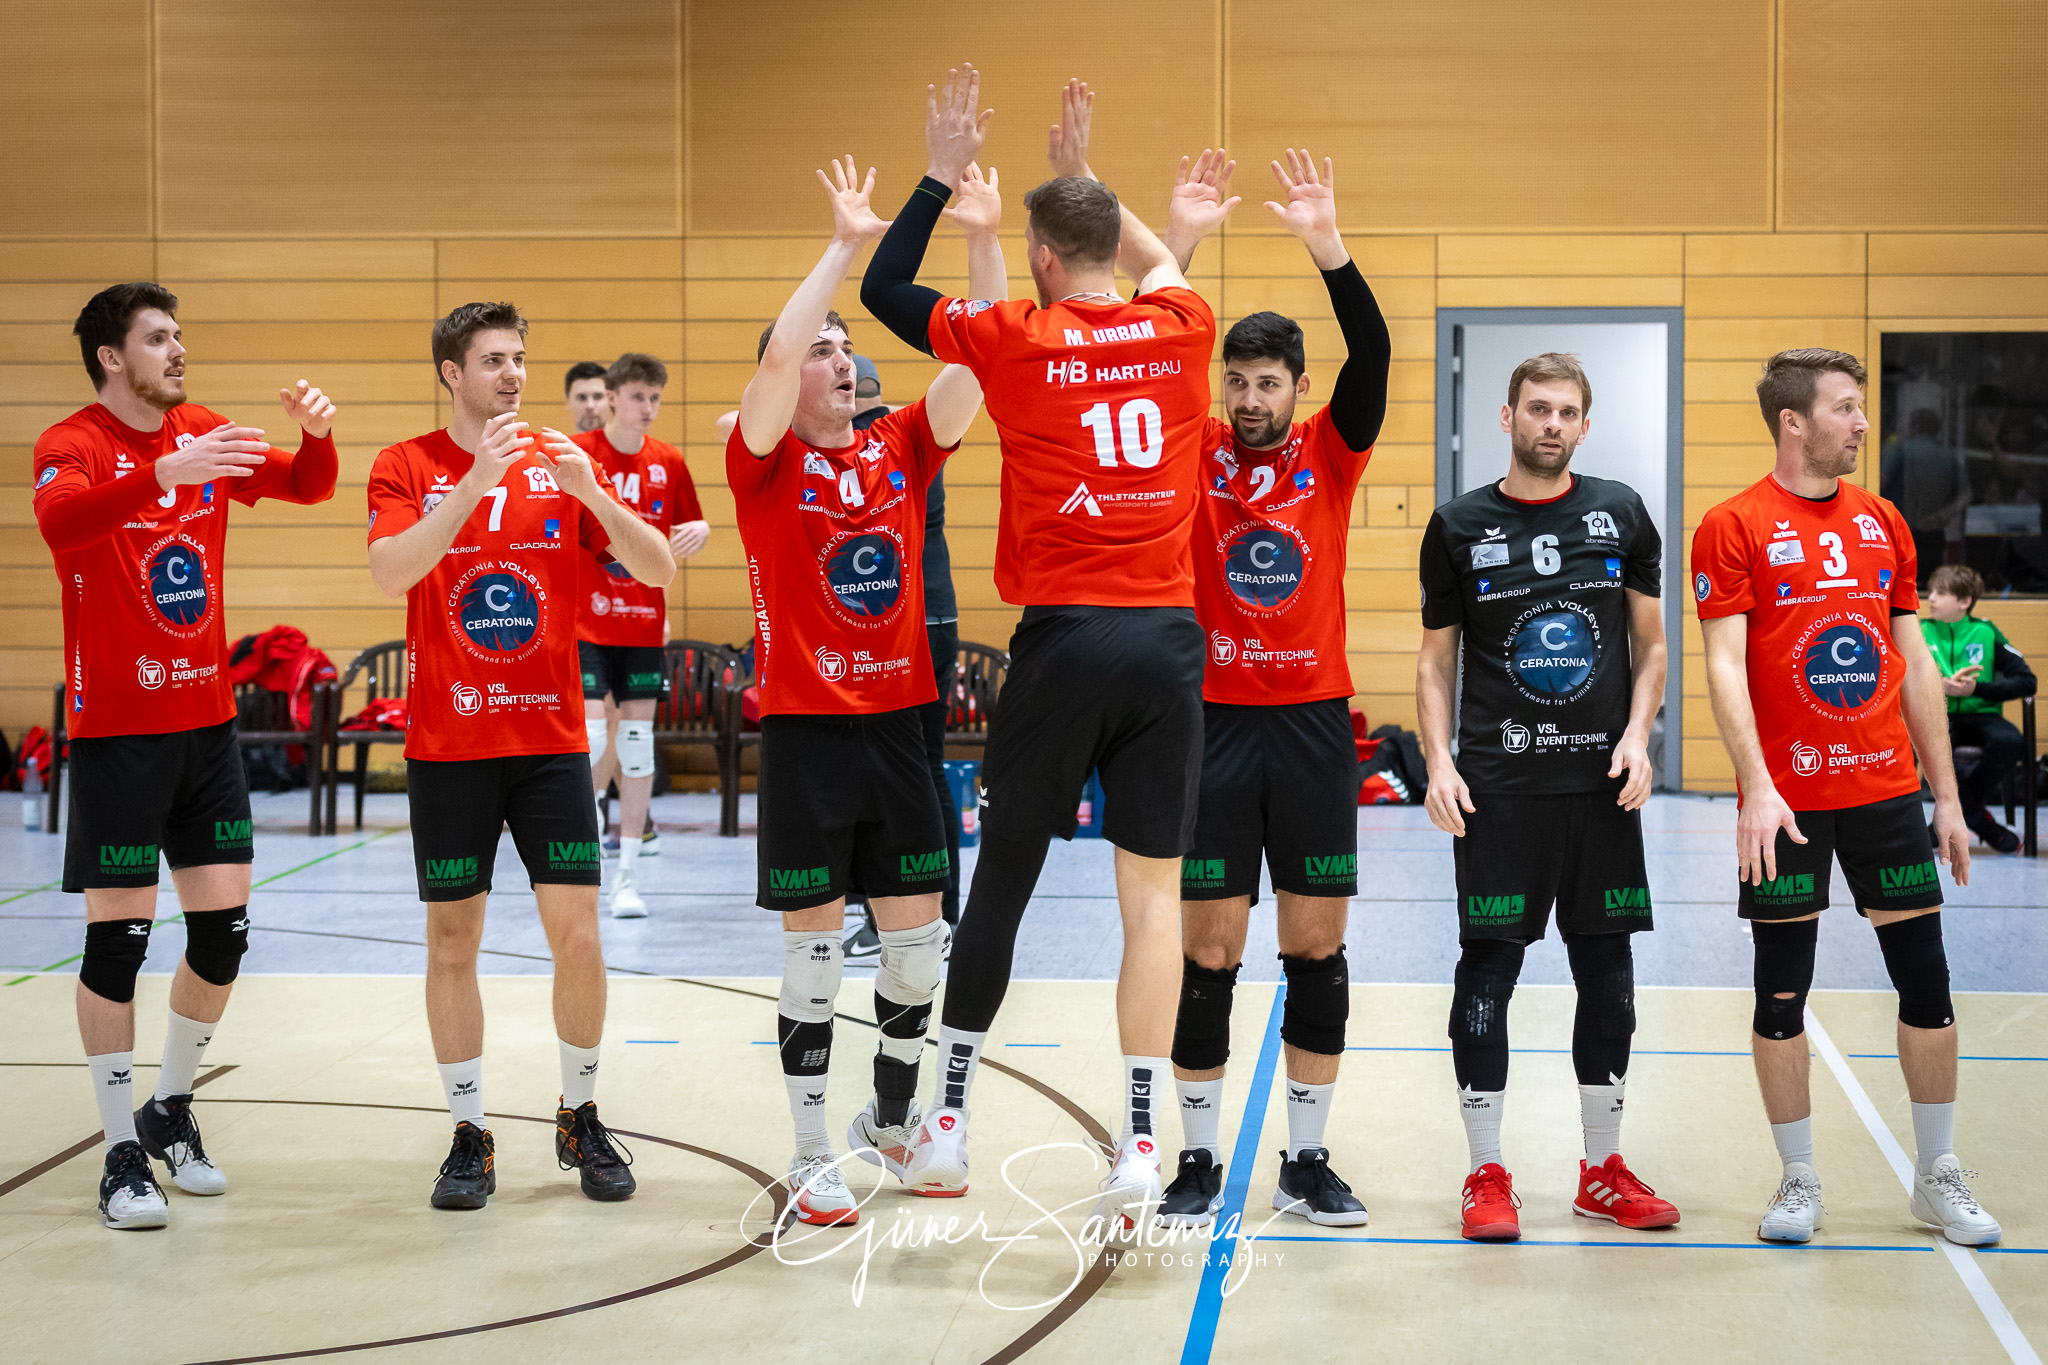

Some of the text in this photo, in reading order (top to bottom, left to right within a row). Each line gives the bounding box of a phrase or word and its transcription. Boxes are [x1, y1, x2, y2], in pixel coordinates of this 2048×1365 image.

[1064, 320, 1156, 346] M. URBAN
[1096, 364, 1146, 382] HART
[1149, 359, 1182, 378] BAU
[1080, 398, 1164, 469] 10
[611, 472, 640, 504] 14
[838, 468, 866, 508] 4
[1248, 465, 1276, 503] 2
[482, 486, 508, 532] 7
[1216, 518, 1310, 554] CERATONIA VOLLEYS
[1585, 538, 1620, 546] abrasives
[1772, 530, 1798, 540] erima
[510, 542, 561, 550] CUADRUM
[1250, 540, 1277, 570] C
[1531, 534, 1562, 576] 6
[1818, 531, 1848, 578] 3
[140, 534, 175, 580] CERATONIA
[852, 546, 878, 576] C
[167, 556, 188, 584] C
[1228, 572, 1298, 585] CERATONIA
[448, 560, 547, 607] CERATONIA VOLLEYS
[834, 578, 898, 595] CERATONIA
[1570, 582, 1622, 590] CUADRUM
[156, 588, 206, 604] CERATONIA
[484, 584, 512, 612] C
[820, 581, 835, 610] quality
[836, 610, 867, 629] diamond
[884, 599, 906, 626] brilliant
[1276, 590, 1302, 616] brilliant
[1477, 588, 1531, 602] UMBRAGROUP
[1775, 594, 1827, 606] UMBRAGROUP
[142, 594, 157, 622] quality
[158, 622, 186, 638] diamond
[466, 617, 534, 630] CERATONIA
[1504, 600, 1601, 647] CERATONIA VOLLEYS
[450, 620, 466, 648] quality
[468, 647, 500, 664] diamond
[503, 656, 514, 664] for
[518, 638, 544, 661] brilliant
[1243, 638, 1264, 650] VSL
[1540, 622, 1568, 651] C
[1792, 611, 1888, 660] CERATONIA VOLLEYS
[852, 650, 874, 662] VSL
[1830, 636, 1858, 666] C
[172, 658, 190, 669] VSL
[1520, 657, 1588, 669] CERATONIA
[487, 683, 508, 694] VSL
[1504, 660, 1519, 688] quality
[1518, 686, 1550, 706] diamond
[1569, 678, 1594, 702] brilliant
[1810, 672, 1876, 685] CERATONIA
[1792, 674, 1810, 704] quality
[1810, 702, 1844, 722] diamond
[1860, 694, 1882, 720] brilliant
[1537, 724, 1560, 734] VSL
[1828, 744, 1852, 754] VSL
[215, 819, 251, 841] LVM
[100, 845, 144, 866] LVM
[216, 840, 252, 850] VERSICHE
[549, 842, 590, 862] LVM
[426, 858, 464, 879] LVM
[900, 852, 940, 874] LVM
[1305, 855, 1349, 876] LVM
[770, 868, 810, 890] LVM
[1880, 864, 1926, 888] LVM
[770, 884, 830, 898] VERSICHERUNG
[1604, 888, 1645, 910] LVM
[1754, 894, 1814, 906] VERSICHERUNG
[1882, 882, 1940, 898] VERSICHERUNG
[1468, 896, 1510, 917] LVM
[800, 1060, 825, 1068] cep
[108, 1077, 132, 1086] erima
[452, 1086, 478, 1097] erima
[1182, 1102, 1211, 1110] erima
[1288, 1095, 1316, 1104] erima
[1463, 1101, 1490, 1110] erima
